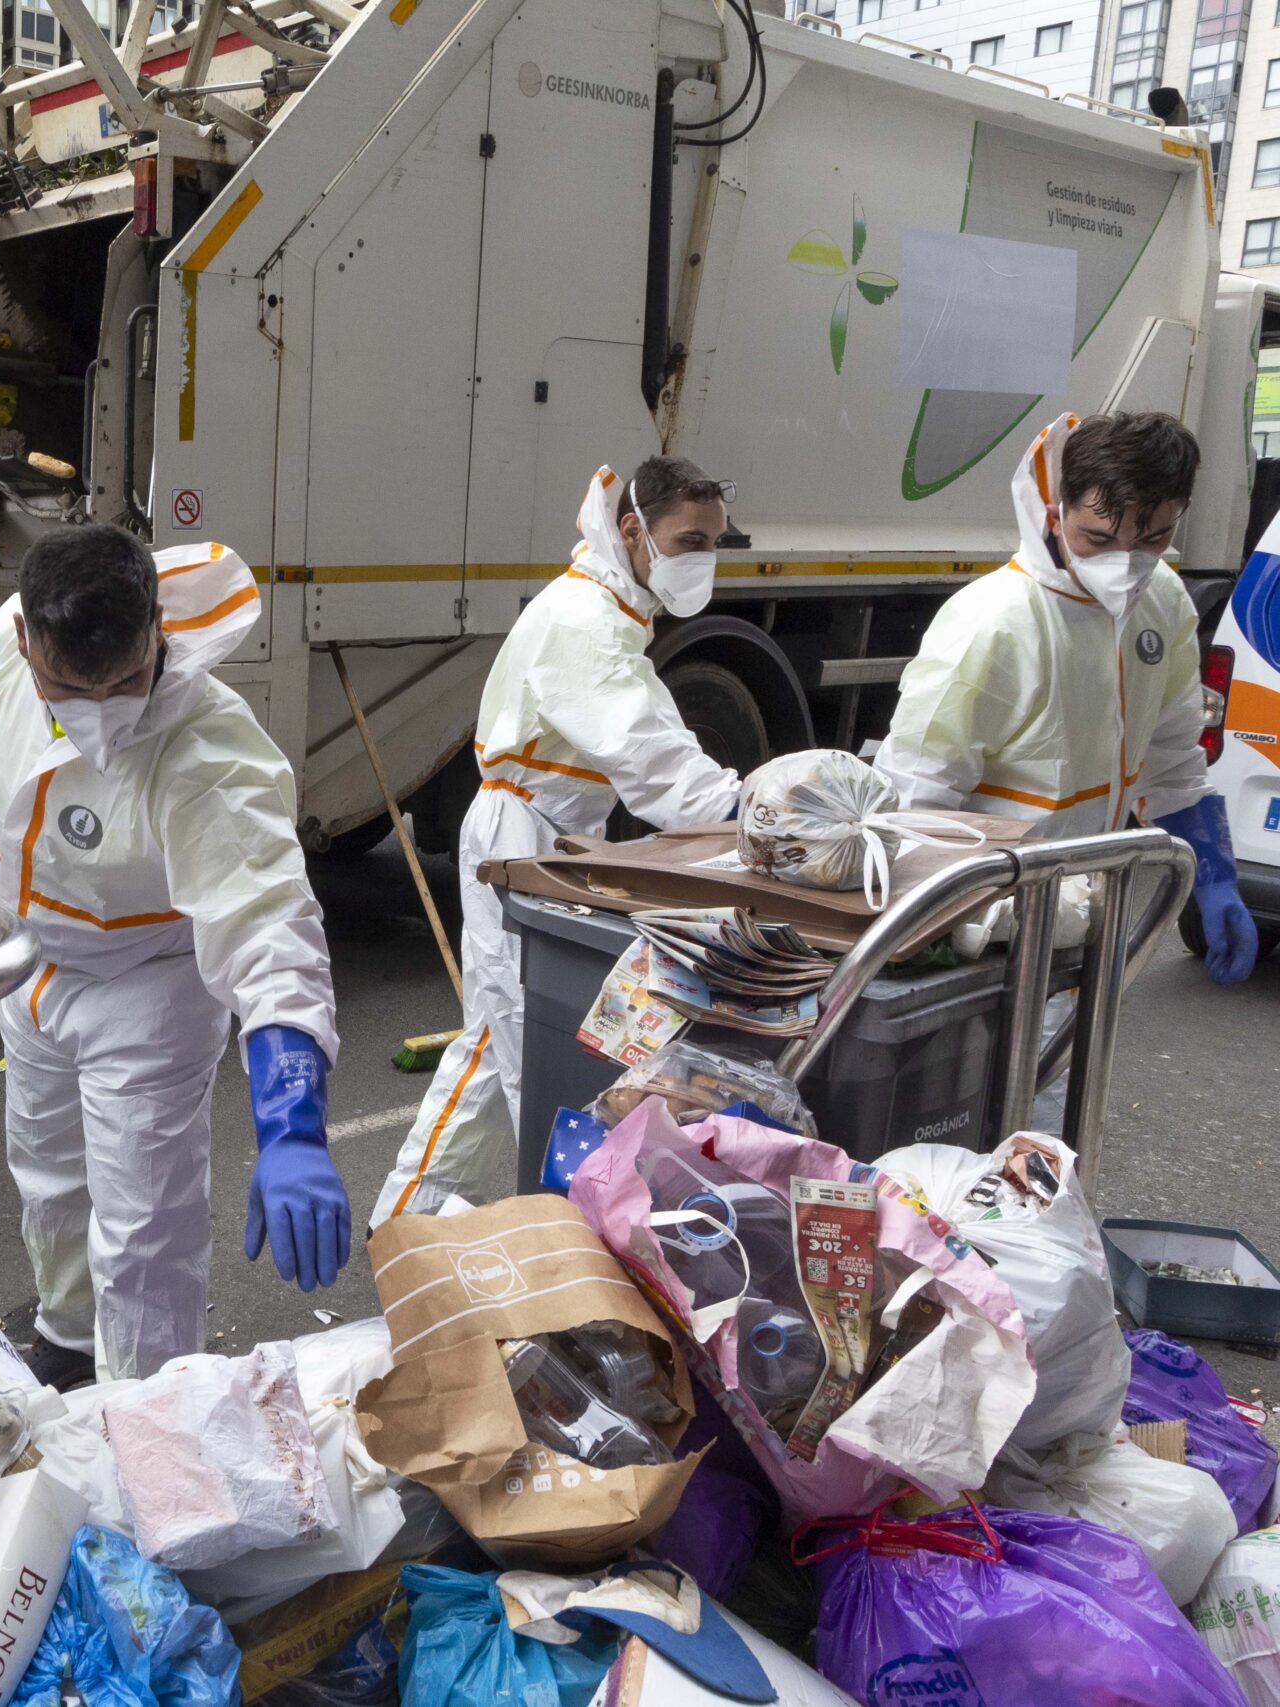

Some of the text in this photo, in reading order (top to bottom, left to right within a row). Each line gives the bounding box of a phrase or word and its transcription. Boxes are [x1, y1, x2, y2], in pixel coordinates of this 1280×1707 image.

[546, 74, 650, 111] GEESINKNORBA
[1047, 181, 1136, 216] Gestión de residuos
[1048, 208, 1123, 238] y limpieza viaria
[1233, 731, 1276, 743] COMBO
[914, 1111, 970, 1142] ORGÁNICA
[808, 1239, 842, 1254] 20€
[843, 1274, 866, 1288] 5€
[884, 1668, 969, 1699] handy
